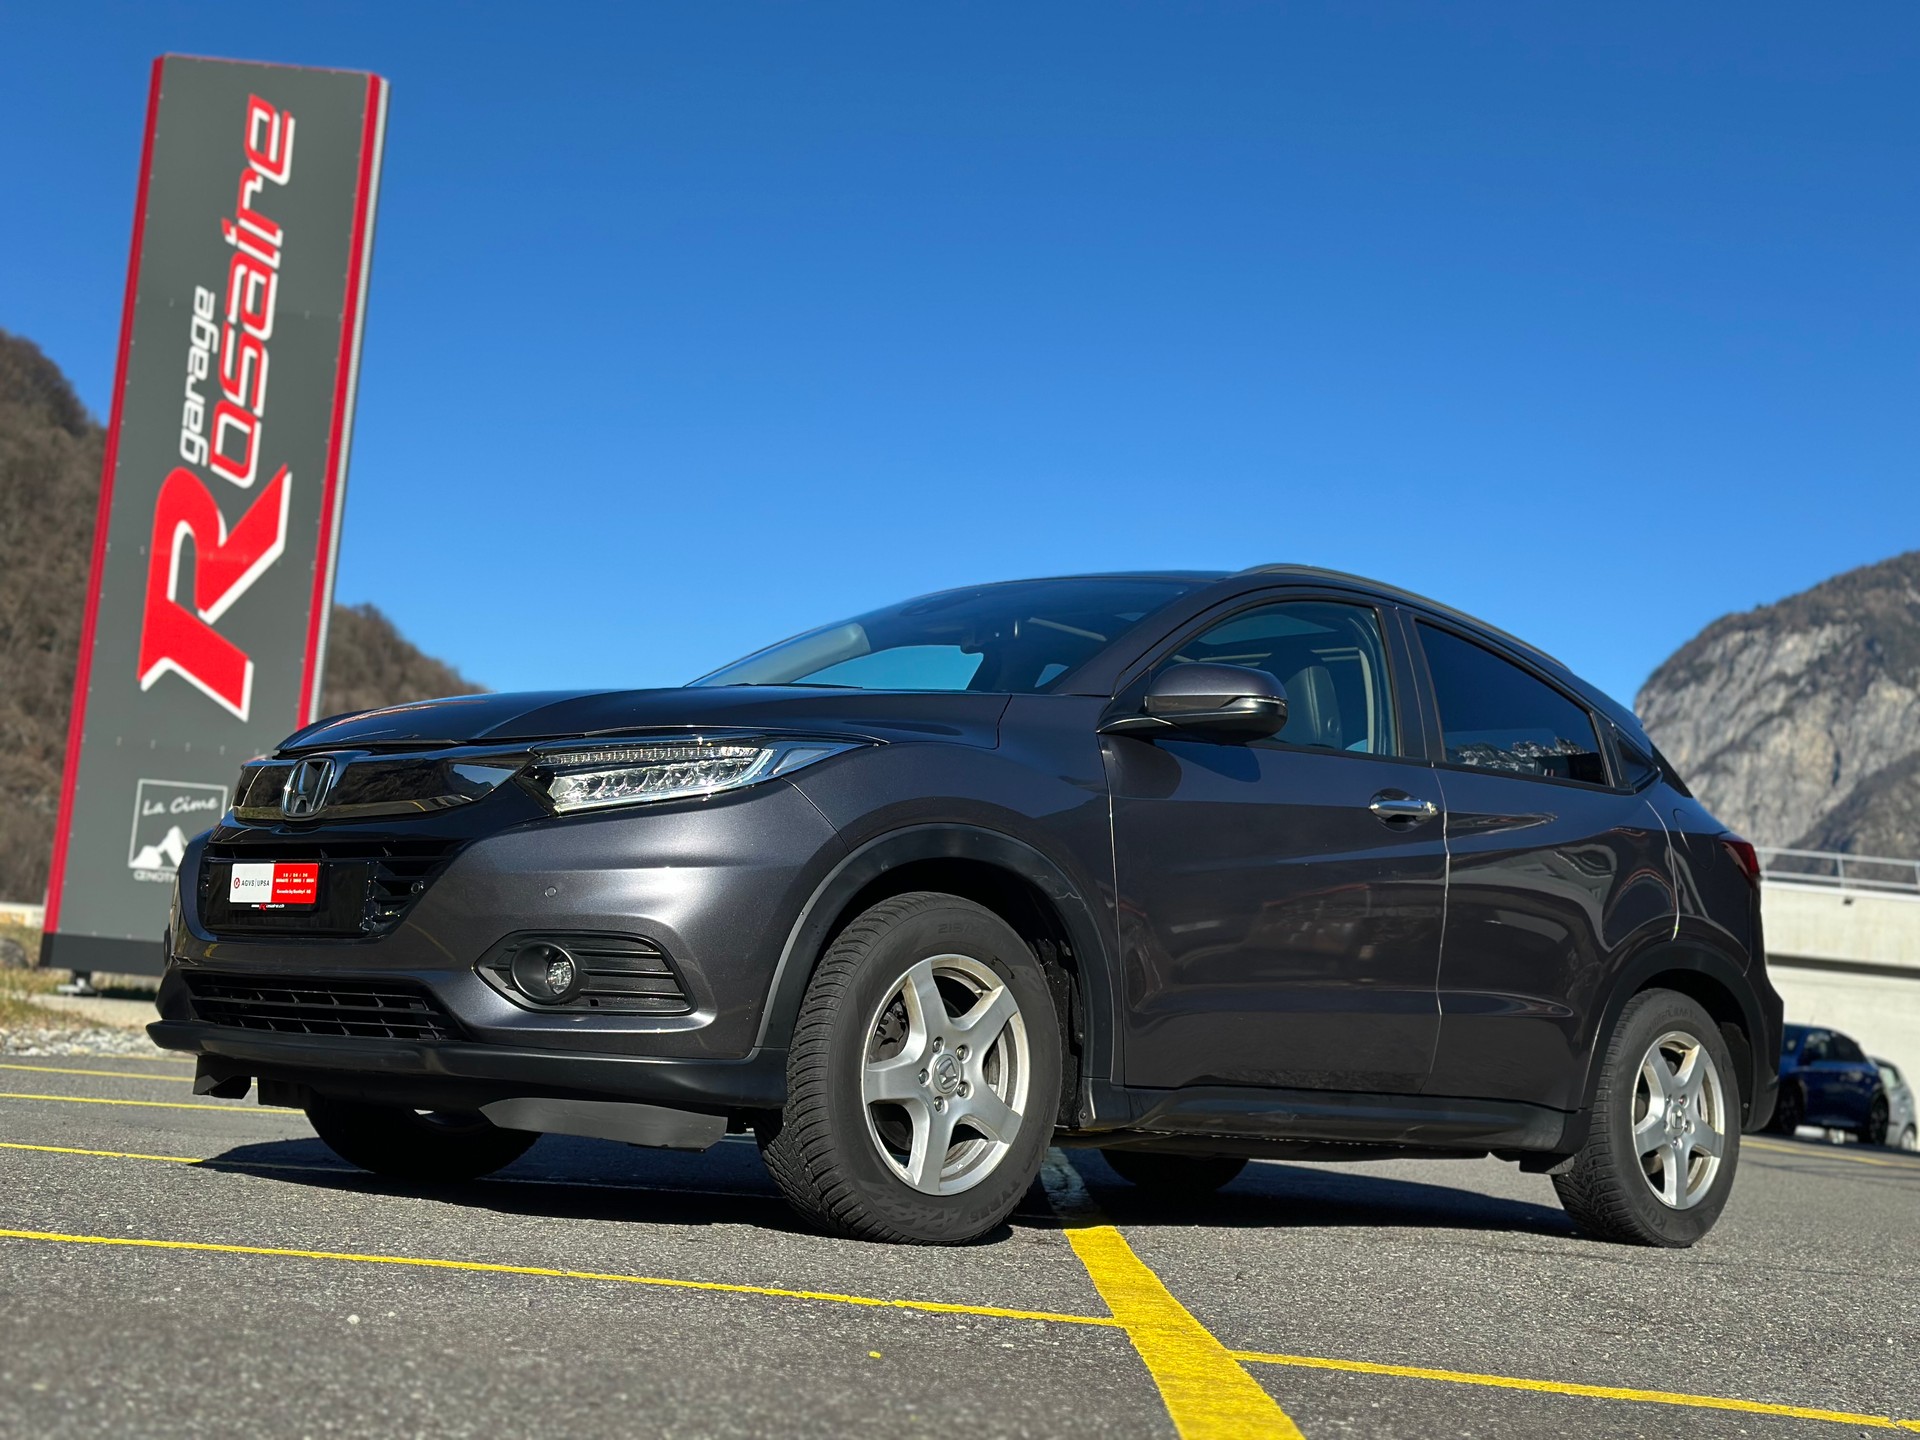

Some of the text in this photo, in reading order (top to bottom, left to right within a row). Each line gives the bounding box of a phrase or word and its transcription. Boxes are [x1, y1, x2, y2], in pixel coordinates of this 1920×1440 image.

[136, 93, 296, 722] Rosaire
[180, 285, 216, 467] garage
[142, 796, 219, 816] La Cime
